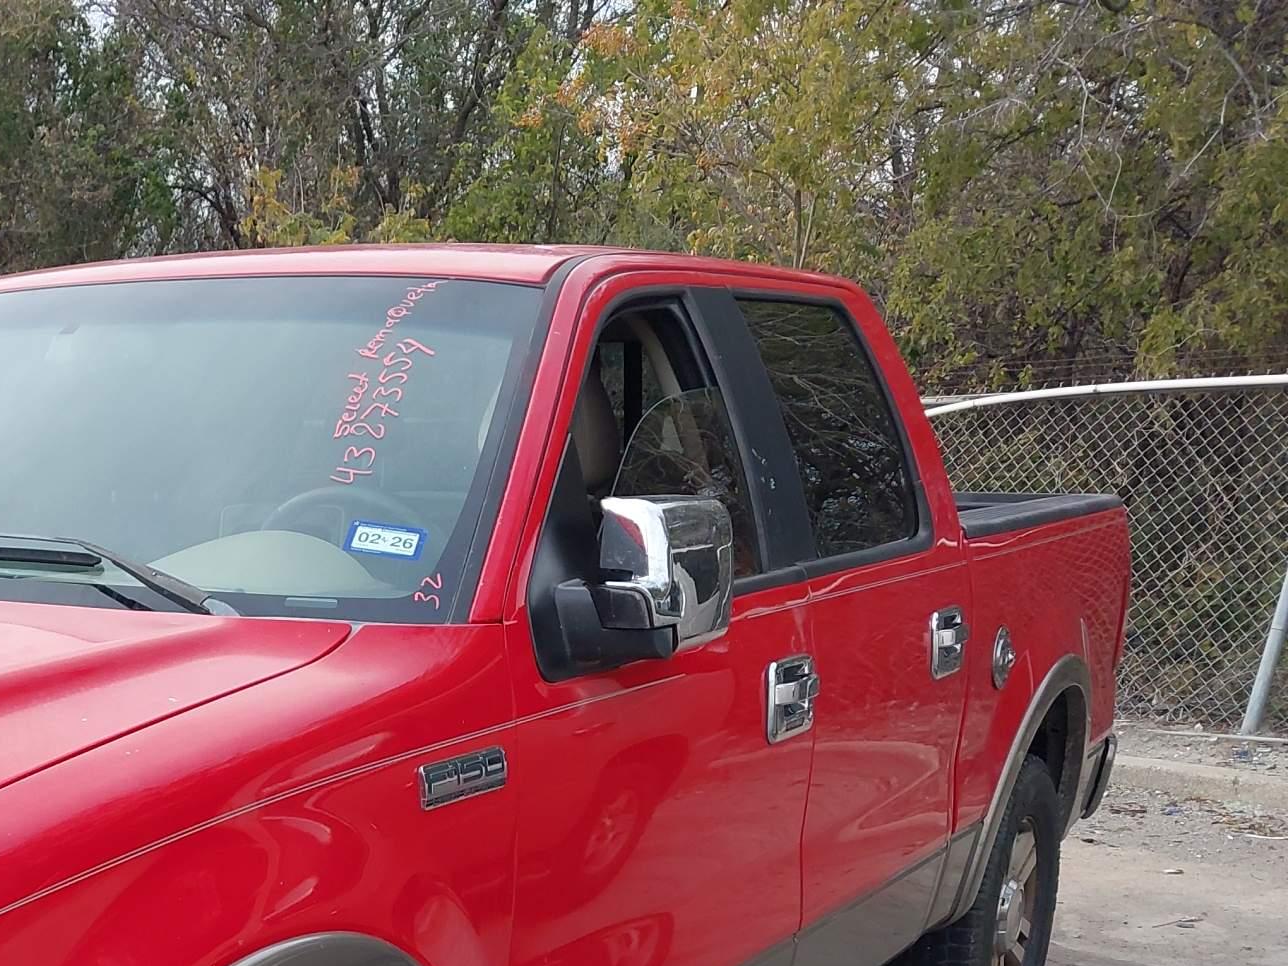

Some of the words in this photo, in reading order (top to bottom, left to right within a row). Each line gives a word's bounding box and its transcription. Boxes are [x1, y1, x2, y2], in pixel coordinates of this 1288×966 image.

[358, 532, 381, 544] 02
[390, 536, 414, 549] 26
[414, 573, 442, 610] 32
